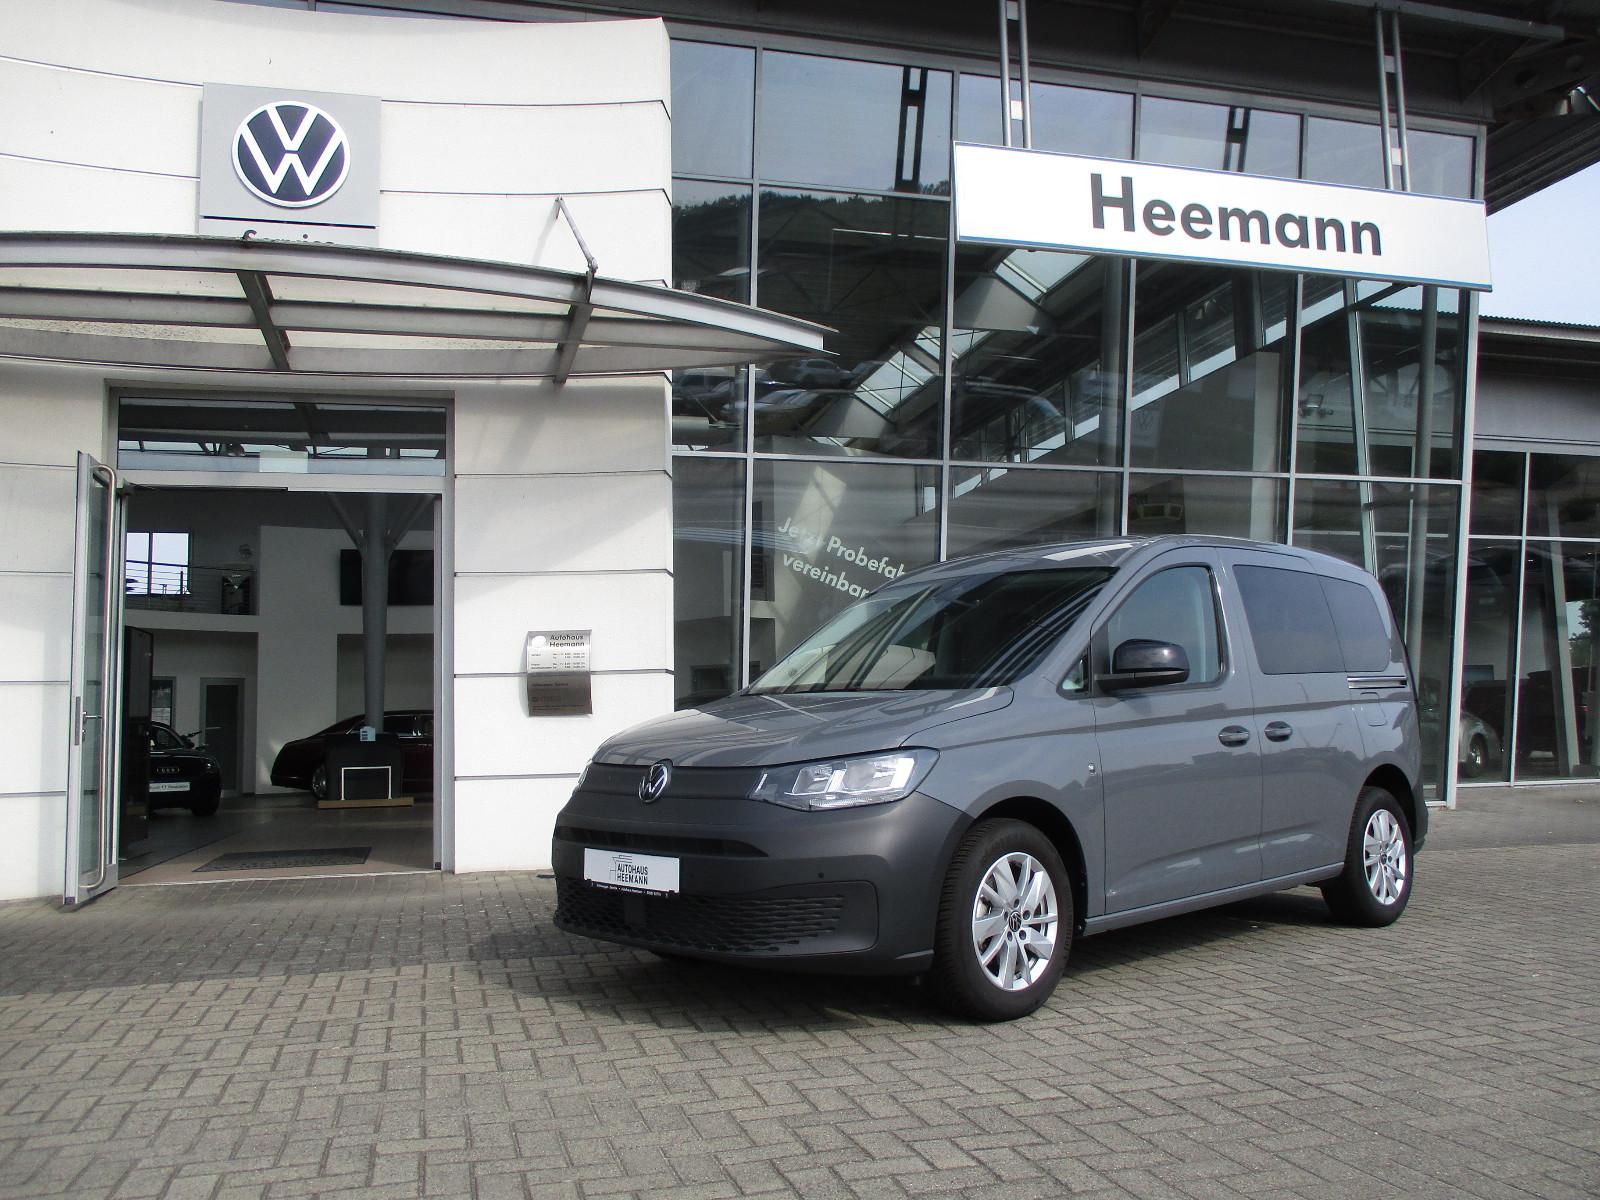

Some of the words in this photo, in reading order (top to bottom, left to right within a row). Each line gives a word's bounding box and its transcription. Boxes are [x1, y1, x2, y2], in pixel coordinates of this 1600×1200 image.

[1090, 172, 1382, 257] Heemann
[617, 863, 649, 876] AUTOHAUS
[616, 872, 649, 885] HEEMANN
